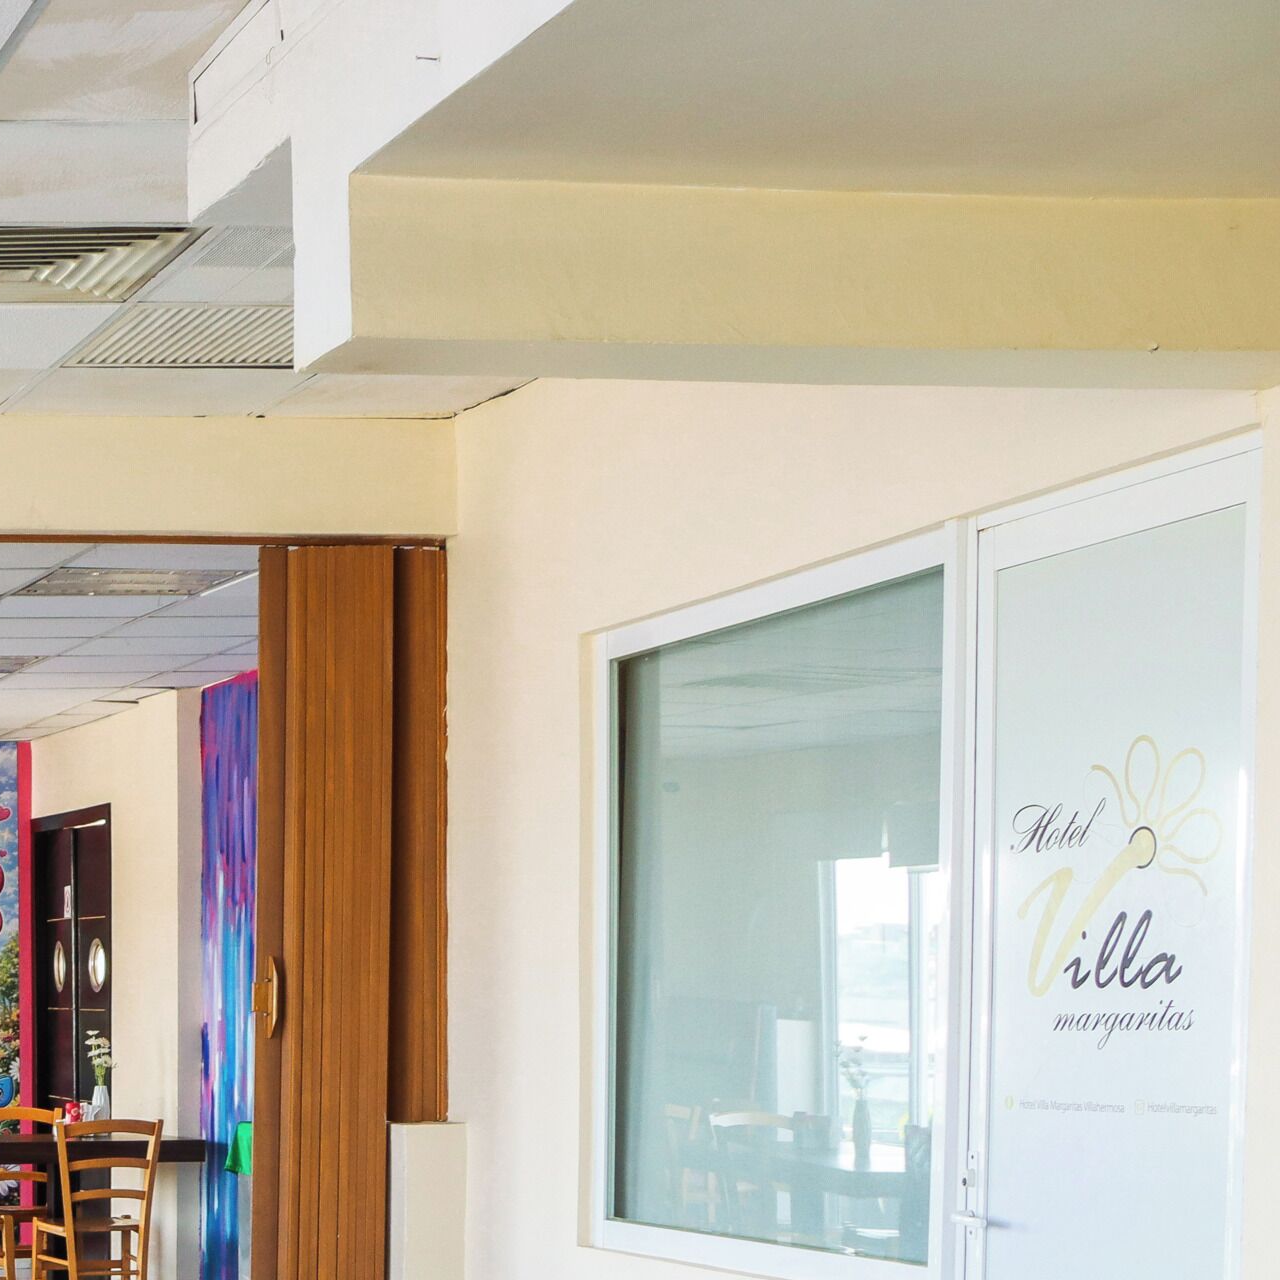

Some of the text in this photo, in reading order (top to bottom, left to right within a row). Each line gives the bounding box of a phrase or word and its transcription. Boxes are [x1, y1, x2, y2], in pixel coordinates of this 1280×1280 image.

[1010, 797, 1106, 853] Hotel
[1017, 848, 1183, 998] Villa
[1053, 1000, 1195, 1050] margaritas
